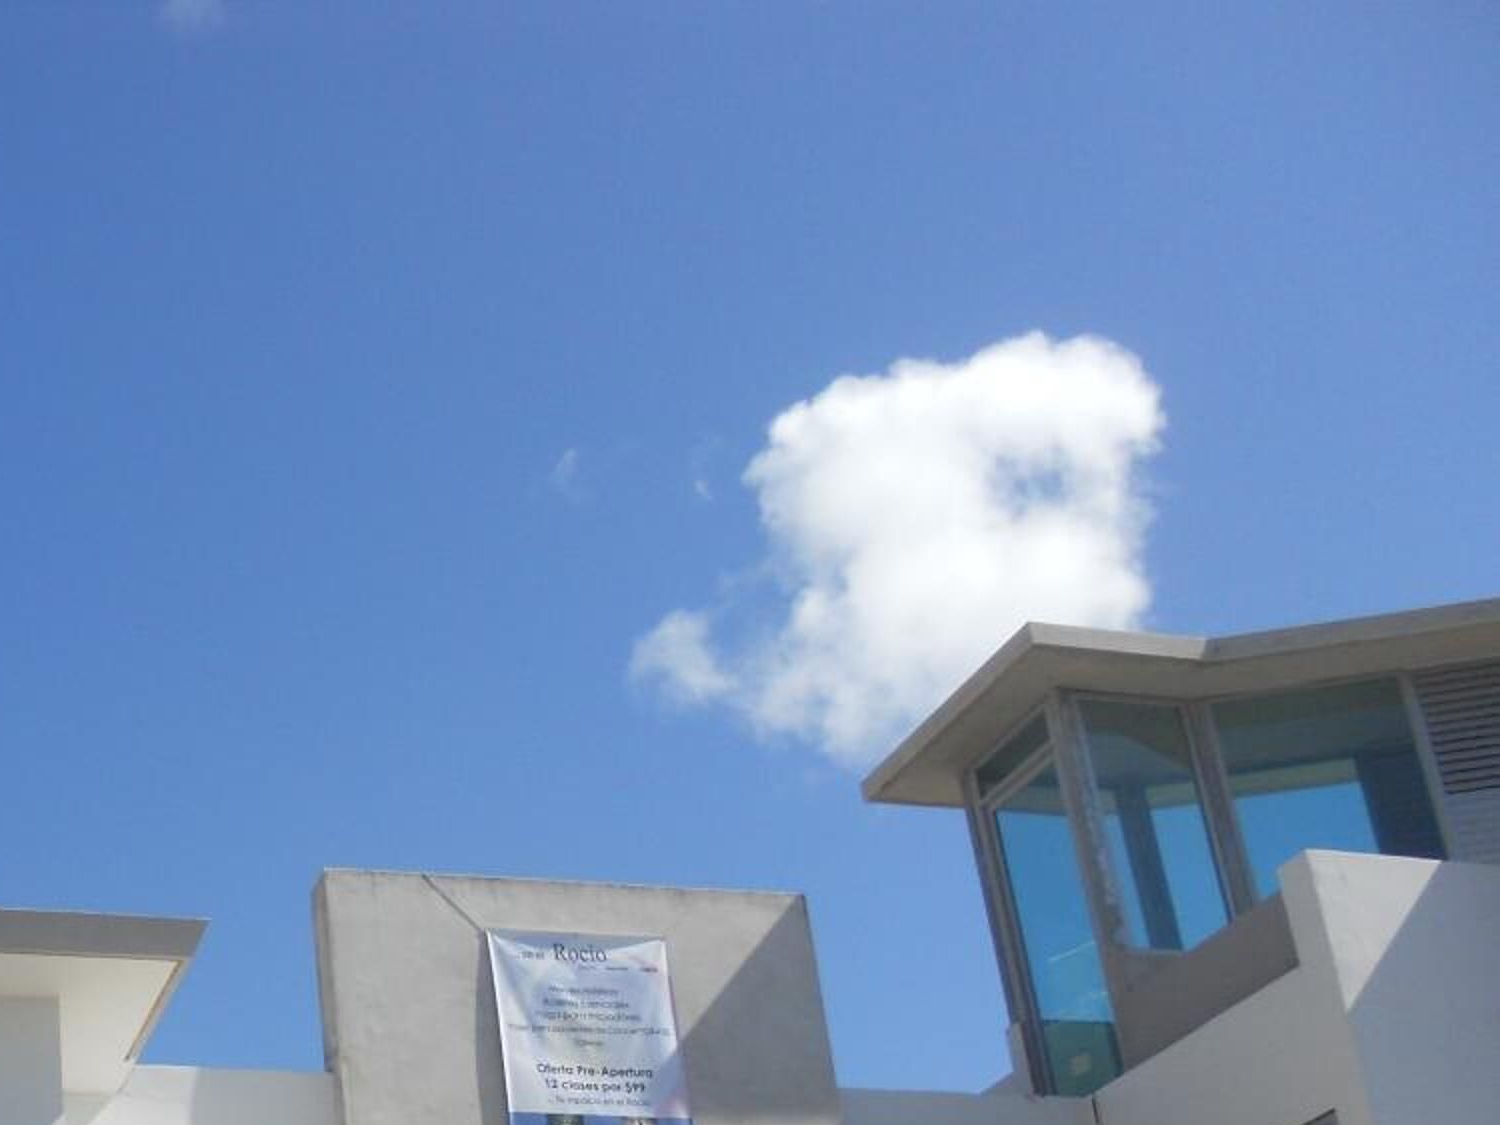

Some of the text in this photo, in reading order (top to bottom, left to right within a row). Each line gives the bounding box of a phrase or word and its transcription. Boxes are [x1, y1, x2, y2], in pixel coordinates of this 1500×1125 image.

[536, 1062, 653, 1079] Oferta Pre-Apertura
[545, 1078, 558, 1089] 12
[561, 1080, 599, 1092] clases
[601, 1082, 621, 1093] por
